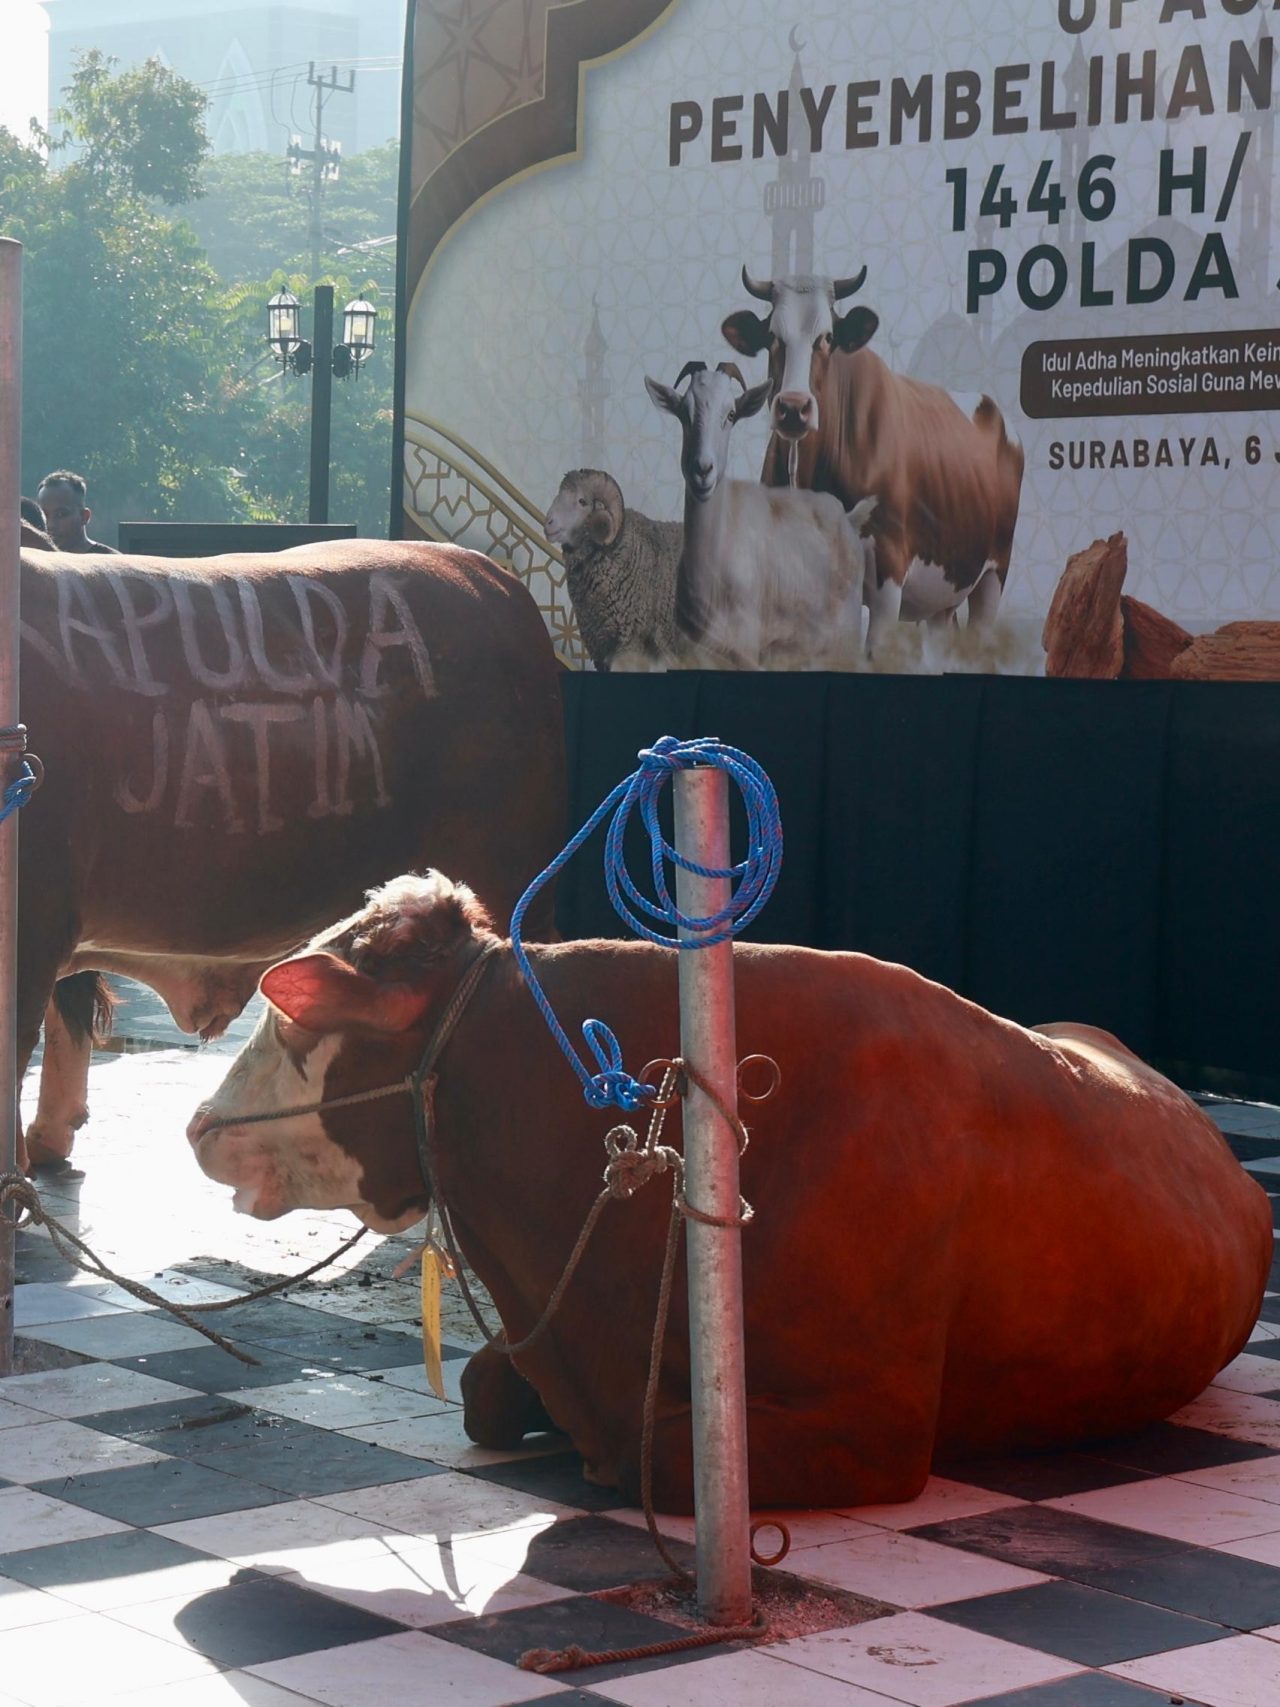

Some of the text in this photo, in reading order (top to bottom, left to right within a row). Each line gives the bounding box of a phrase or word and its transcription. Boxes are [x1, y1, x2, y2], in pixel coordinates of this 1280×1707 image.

[669, 36, 1274, 167] PENYEMBELIHAN
[945, 131, 1252, 231] 1446 H/
[967, 232, 1240, 314] POLDA
[1042, 353, 1072, 372] Idul
[1075, 351, 1117, 371] Adha
[1121, 343, 1239, 369] Meningkatkan
[1051, 376, 1142, 401] Kepedulian
[1146, 373, 1198, 394] Sosial
[1201, 372, 1245, 391] Guna
[1049, 436, 1231, 470] SURABAYA,
[1245, 434, 1261, 465] 6
[118, 694, 392, 836] JATIM
